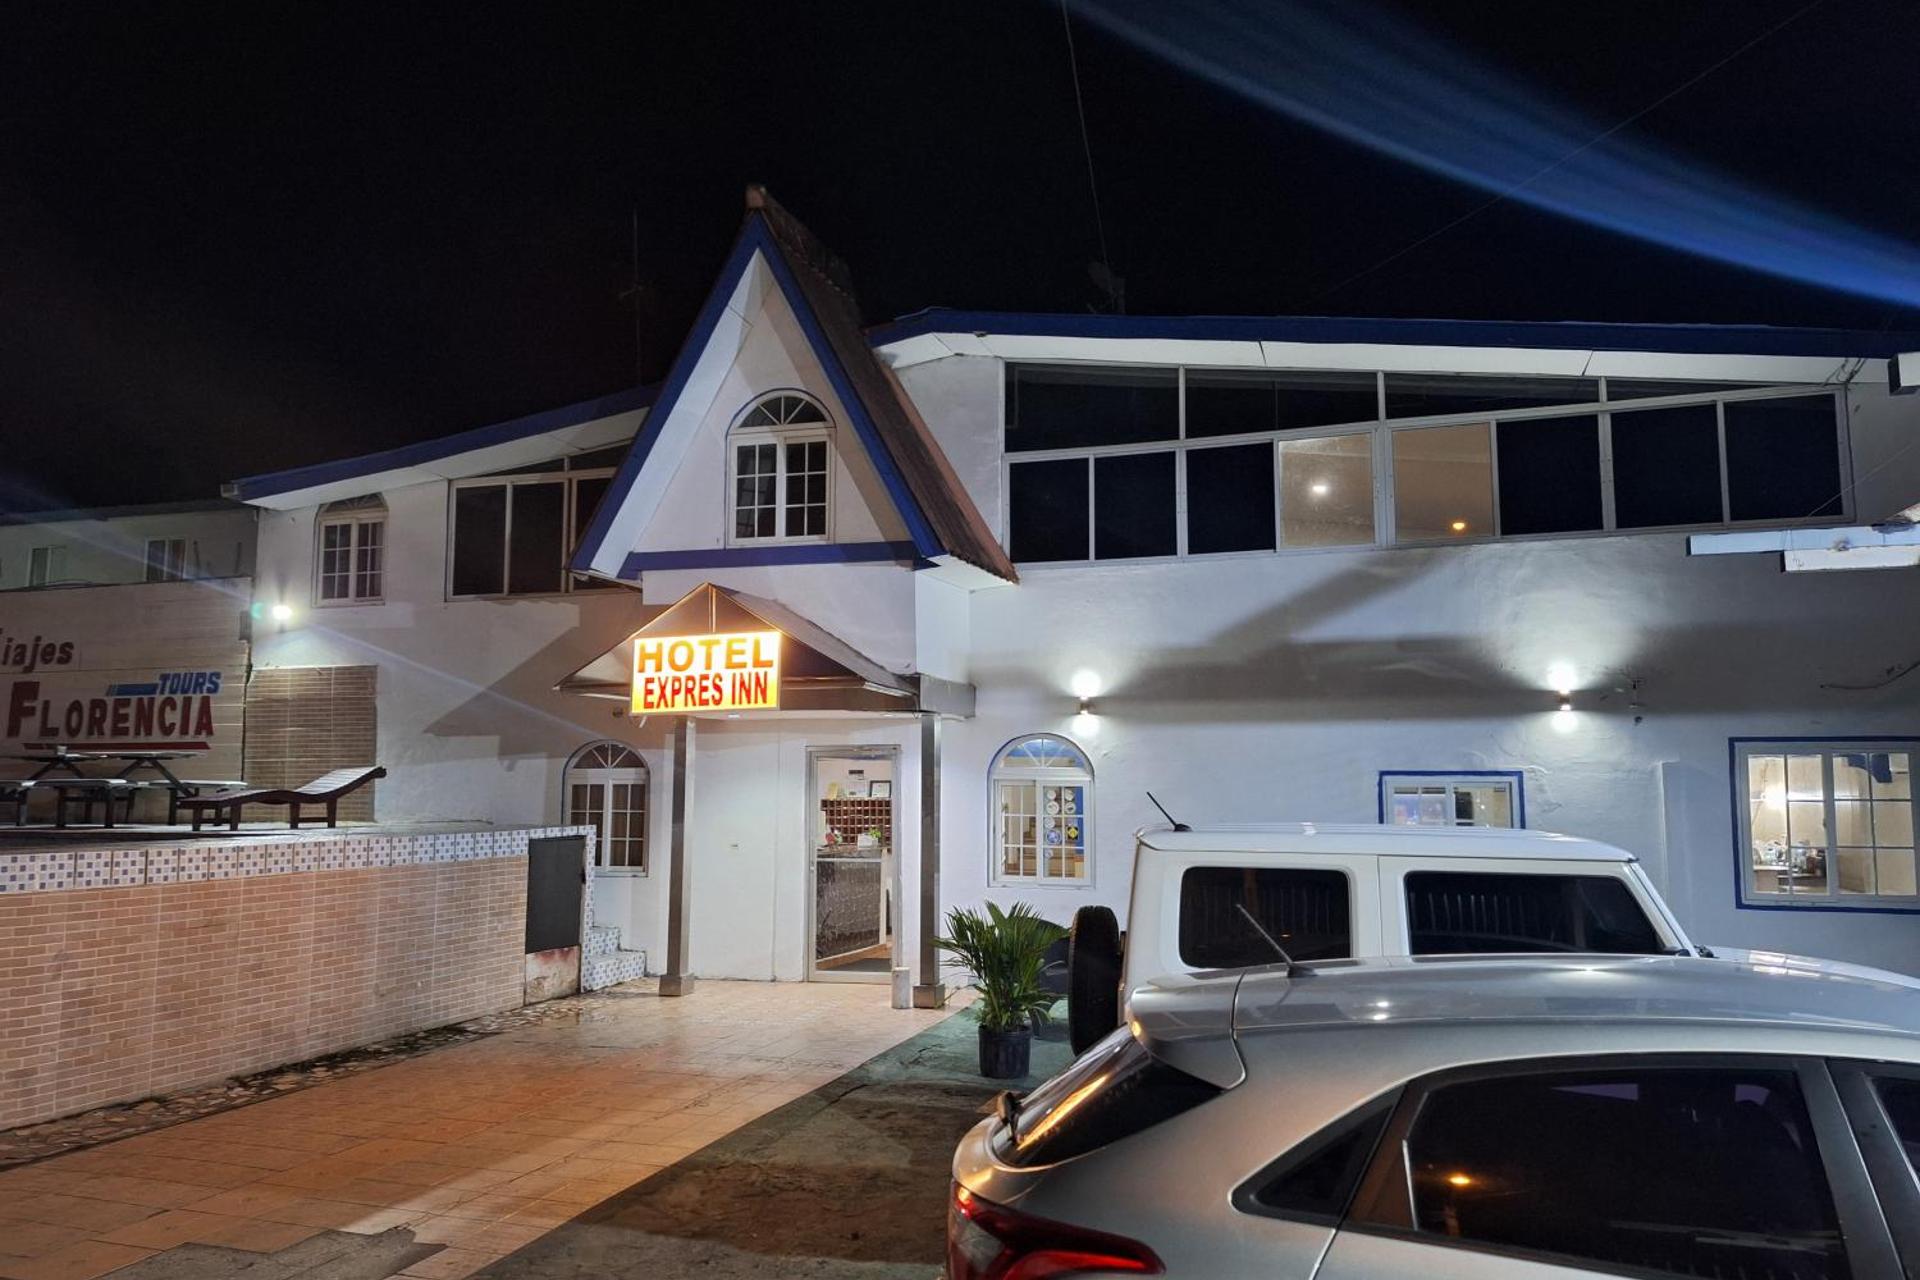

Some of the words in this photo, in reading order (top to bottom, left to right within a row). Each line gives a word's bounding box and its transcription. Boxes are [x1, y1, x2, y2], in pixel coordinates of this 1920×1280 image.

[0, 628, 75, 673] iajes
[637, 636, 774, 673] HOTEL
[158, 671, 222, 696] TOURS
[643, 673, 723, 709] EXPRES
[731, 671, 768, 705] INN
[6, 681, 214, 738] FLORENCIA
